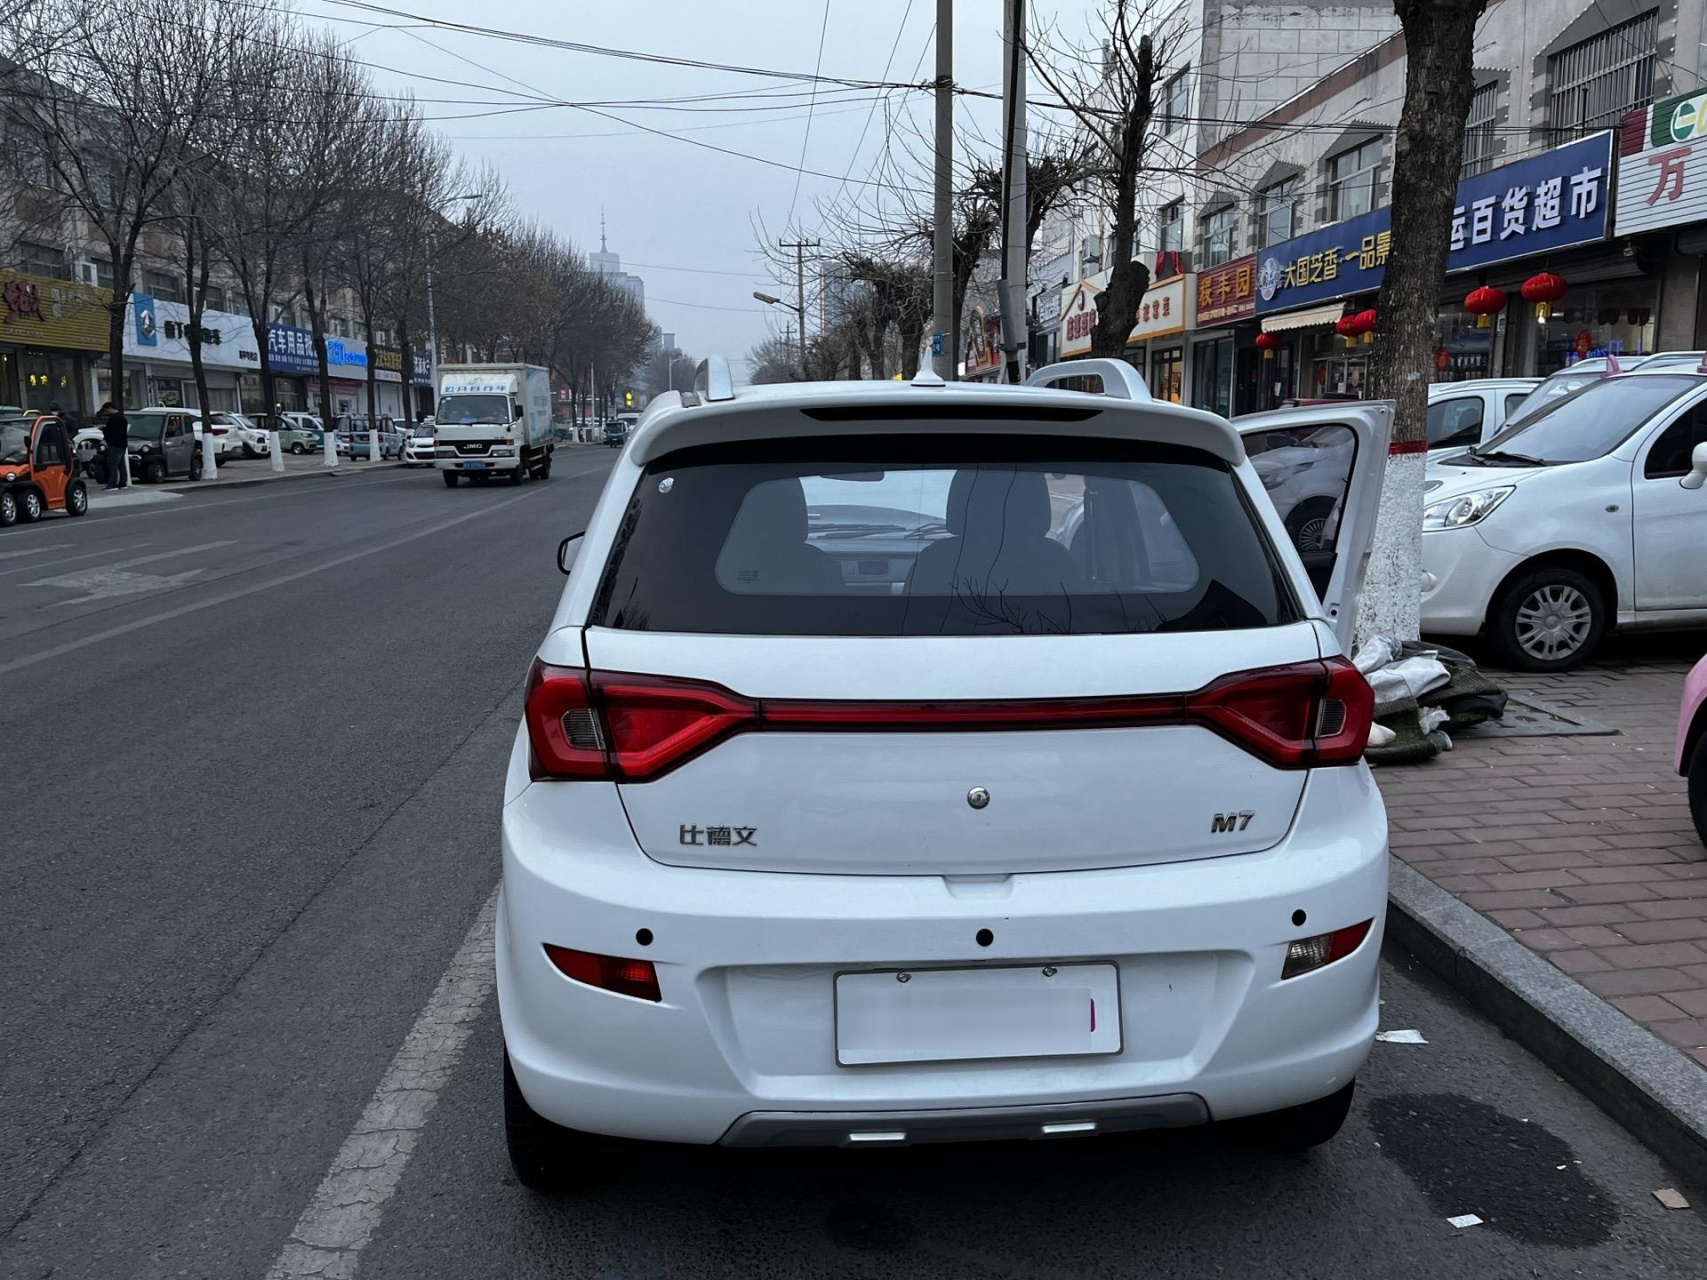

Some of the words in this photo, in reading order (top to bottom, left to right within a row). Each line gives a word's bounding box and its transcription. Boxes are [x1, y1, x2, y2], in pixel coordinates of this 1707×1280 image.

[1646, 146, 1692, 206] 万
[267, 328, 318, 358] 汽车用品批
[1210, 809, 1256, 834] M7
[679, 824, 758, 847] 比德文
